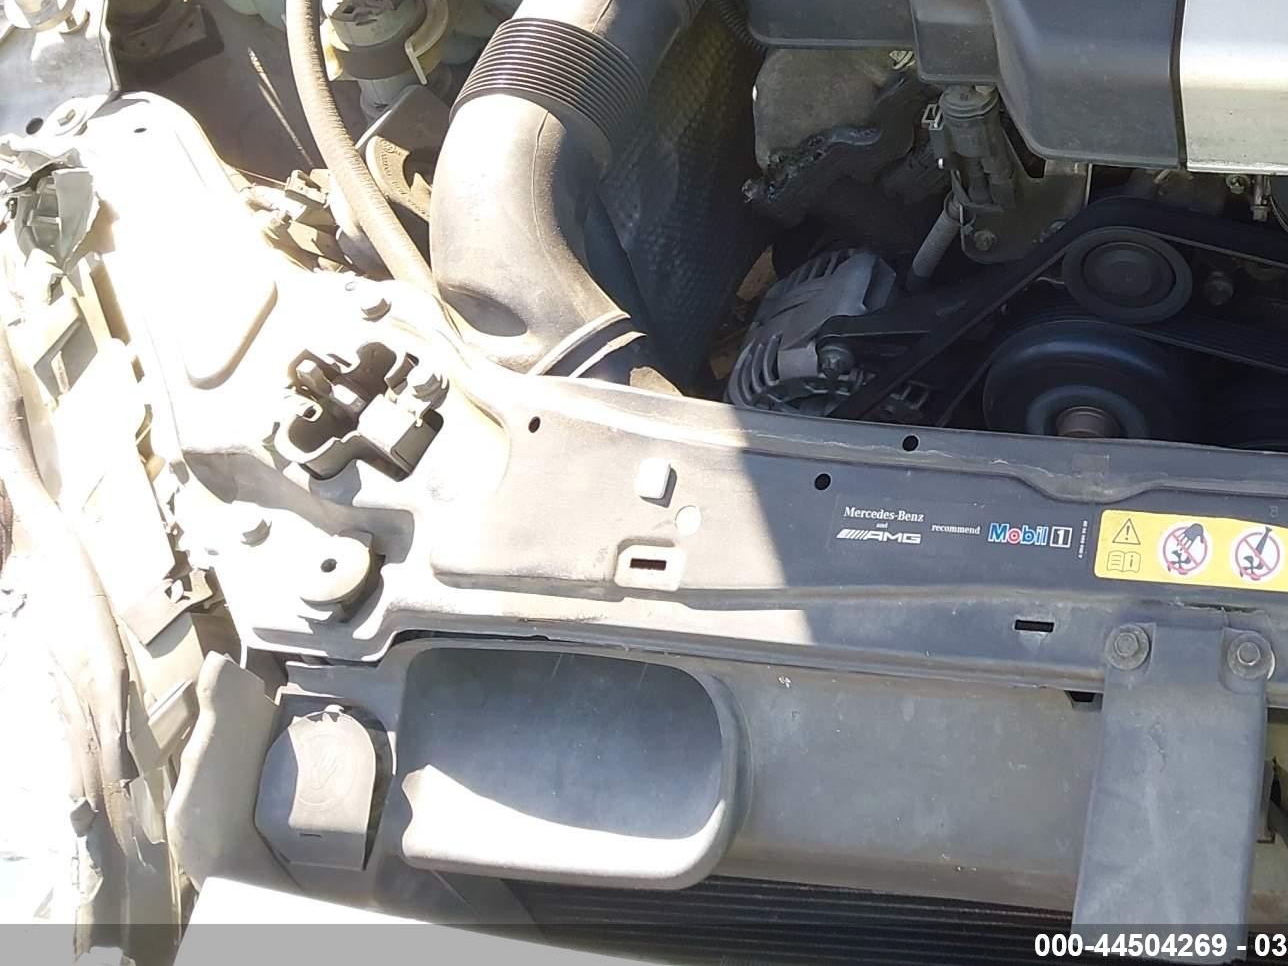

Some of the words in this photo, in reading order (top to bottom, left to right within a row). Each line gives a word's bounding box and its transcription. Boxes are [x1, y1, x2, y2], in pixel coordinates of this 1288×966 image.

[843, 506, 925, 523] Mercedes-Benz
[875, 521, 889, 529] and
[931, 524, 981, 535] recommend
[988, 522, 1049, 546] Mobil
